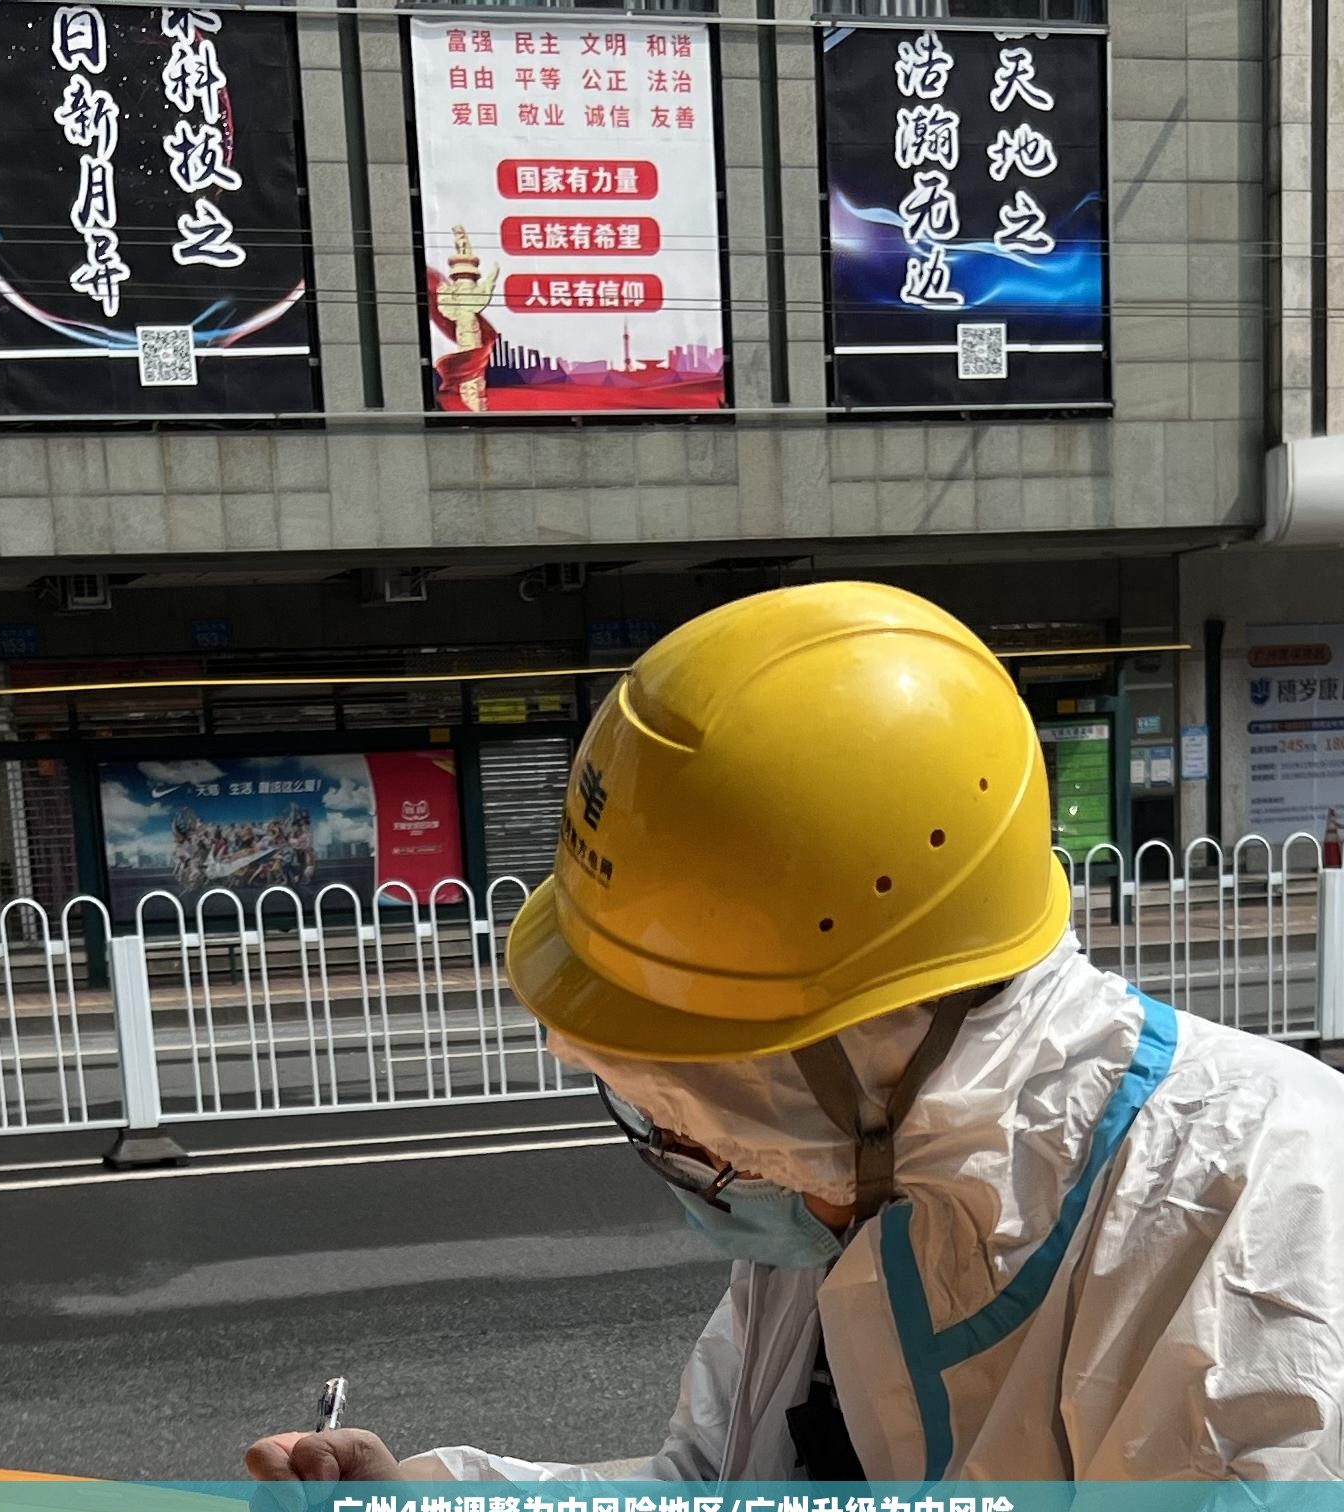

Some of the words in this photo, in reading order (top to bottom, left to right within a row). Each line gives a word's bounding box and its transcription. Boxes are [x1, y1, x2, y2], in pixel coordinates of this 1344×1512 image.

[446, 29, 494, 54] 富强
[514, 31, 561, 56] 民主
[580, 33, 627, 57] 文明
[647, 34, 692, 58] 和谐
[449, 65, 495, 90] 自由
[515, 66, 561, 91] 平等
[581, 68, 628, 92] 公正
[648, 69, 692, 94] 法治
[452, 103, 498, 127] 爱国
[518, 103, 564, 127] 敬业
[584, 104, 630, 129] 诚信
[650, 105, 695, 130] 友善
[988, 32, 1056, 254] 天地之
[52, 6, 131, 317] 日新月异
[895, 30, 963, 306] 浩瀚无边
[516, 166, 639, 194] 国家有力量
[520, 223, 641, 250] 民族有希望
[525, 280, 645, 308] 人民有信仰
